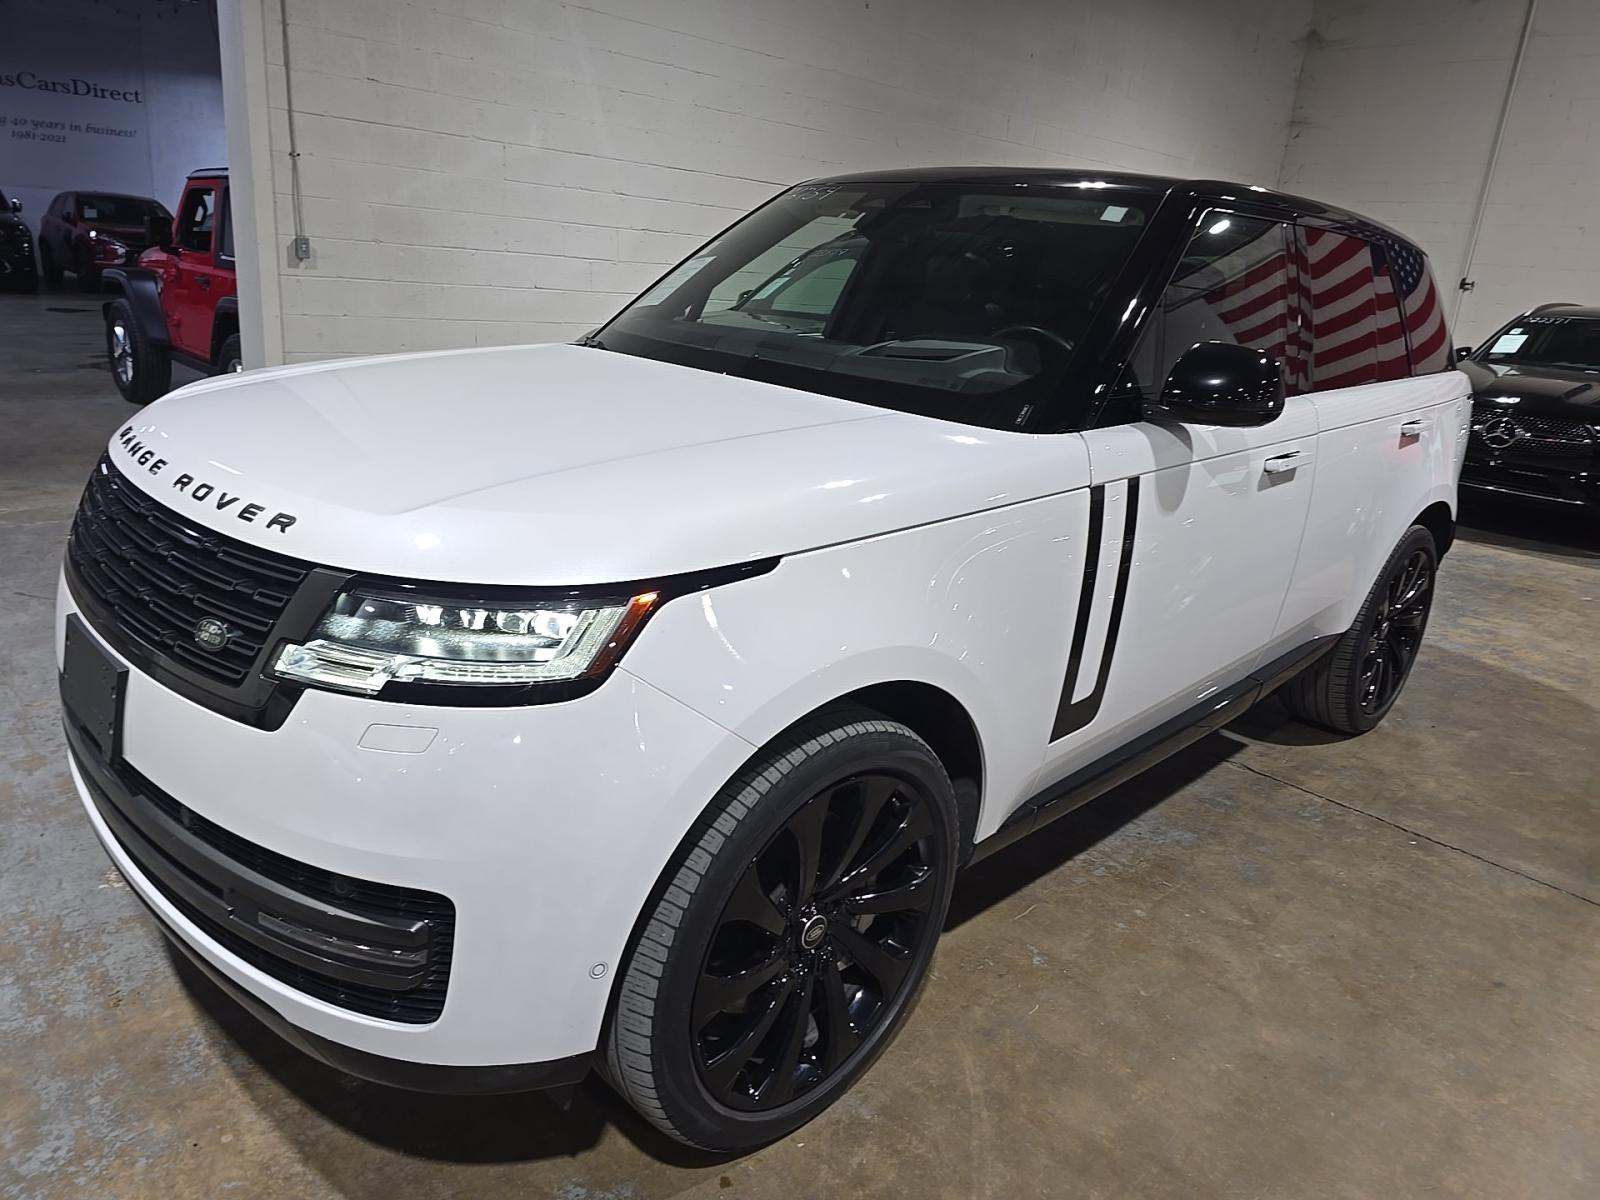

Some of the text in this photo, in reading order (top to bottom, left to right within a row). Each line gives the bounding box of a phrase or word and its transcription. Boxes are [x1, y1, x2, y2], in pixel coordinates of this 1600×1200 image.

[30, 119, 66, 130] years
[70, 121, 83, 132] in
[11, 129, 66, 143] 1981-2021
[118, 425, 298, 534] RANGE ROVER
